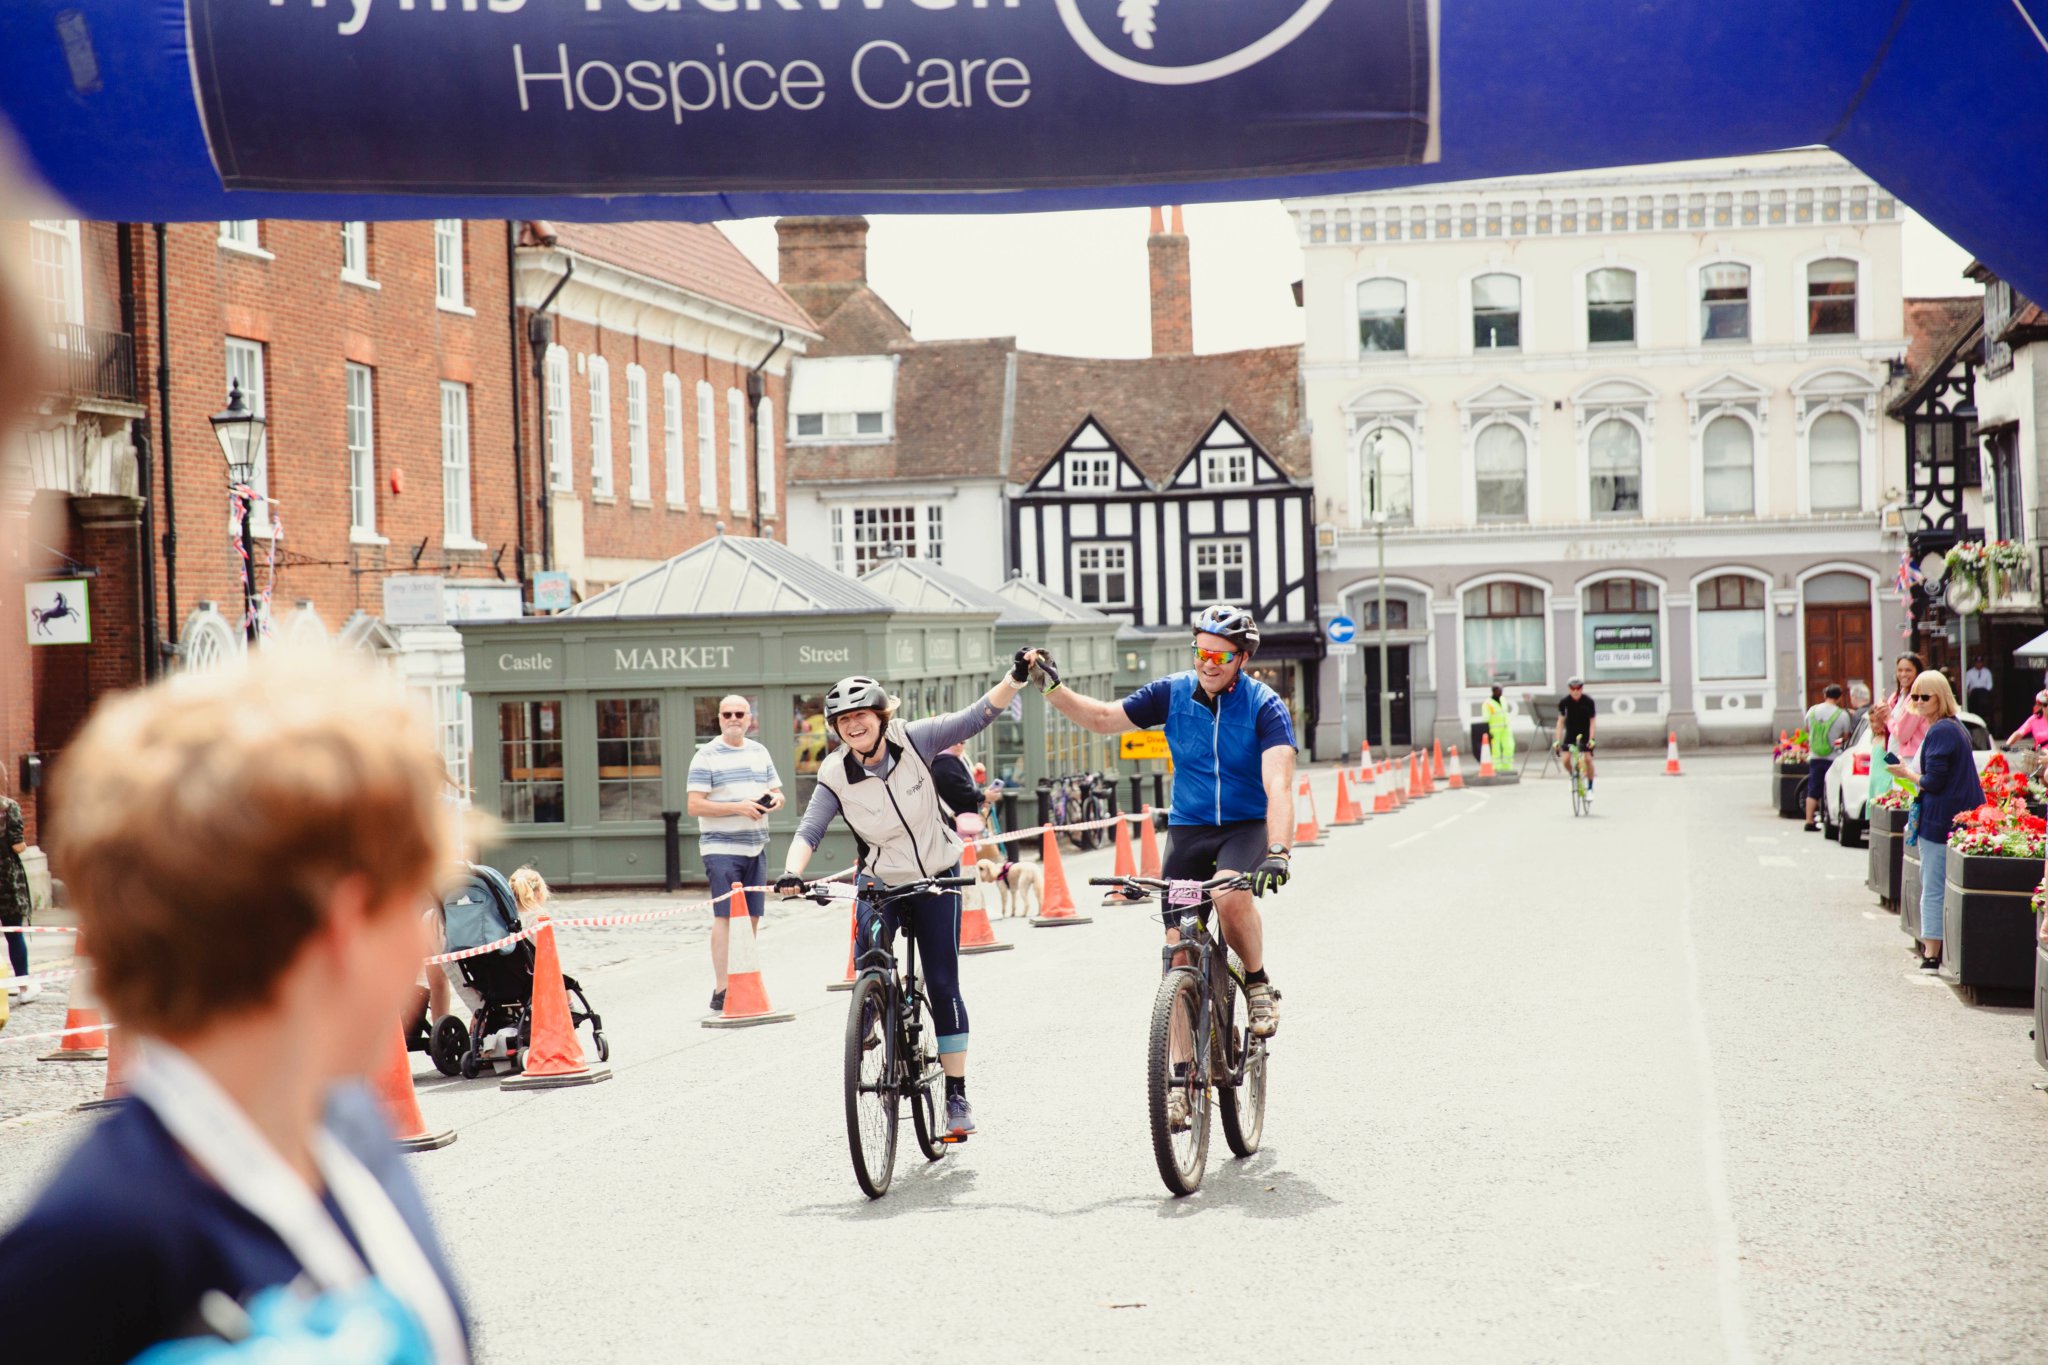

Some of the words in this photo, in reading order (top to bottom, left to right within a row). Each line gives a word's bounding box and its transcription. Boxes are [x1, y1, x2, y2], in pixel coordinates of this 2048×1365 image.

[513, 43, 824, 124] Hospice
[852, 40, 1030, 109] Care
[499, 653, 552, 670] Castle
[614, 646, 734, 670] MARKET
[799, 646, 850, 663] Street
